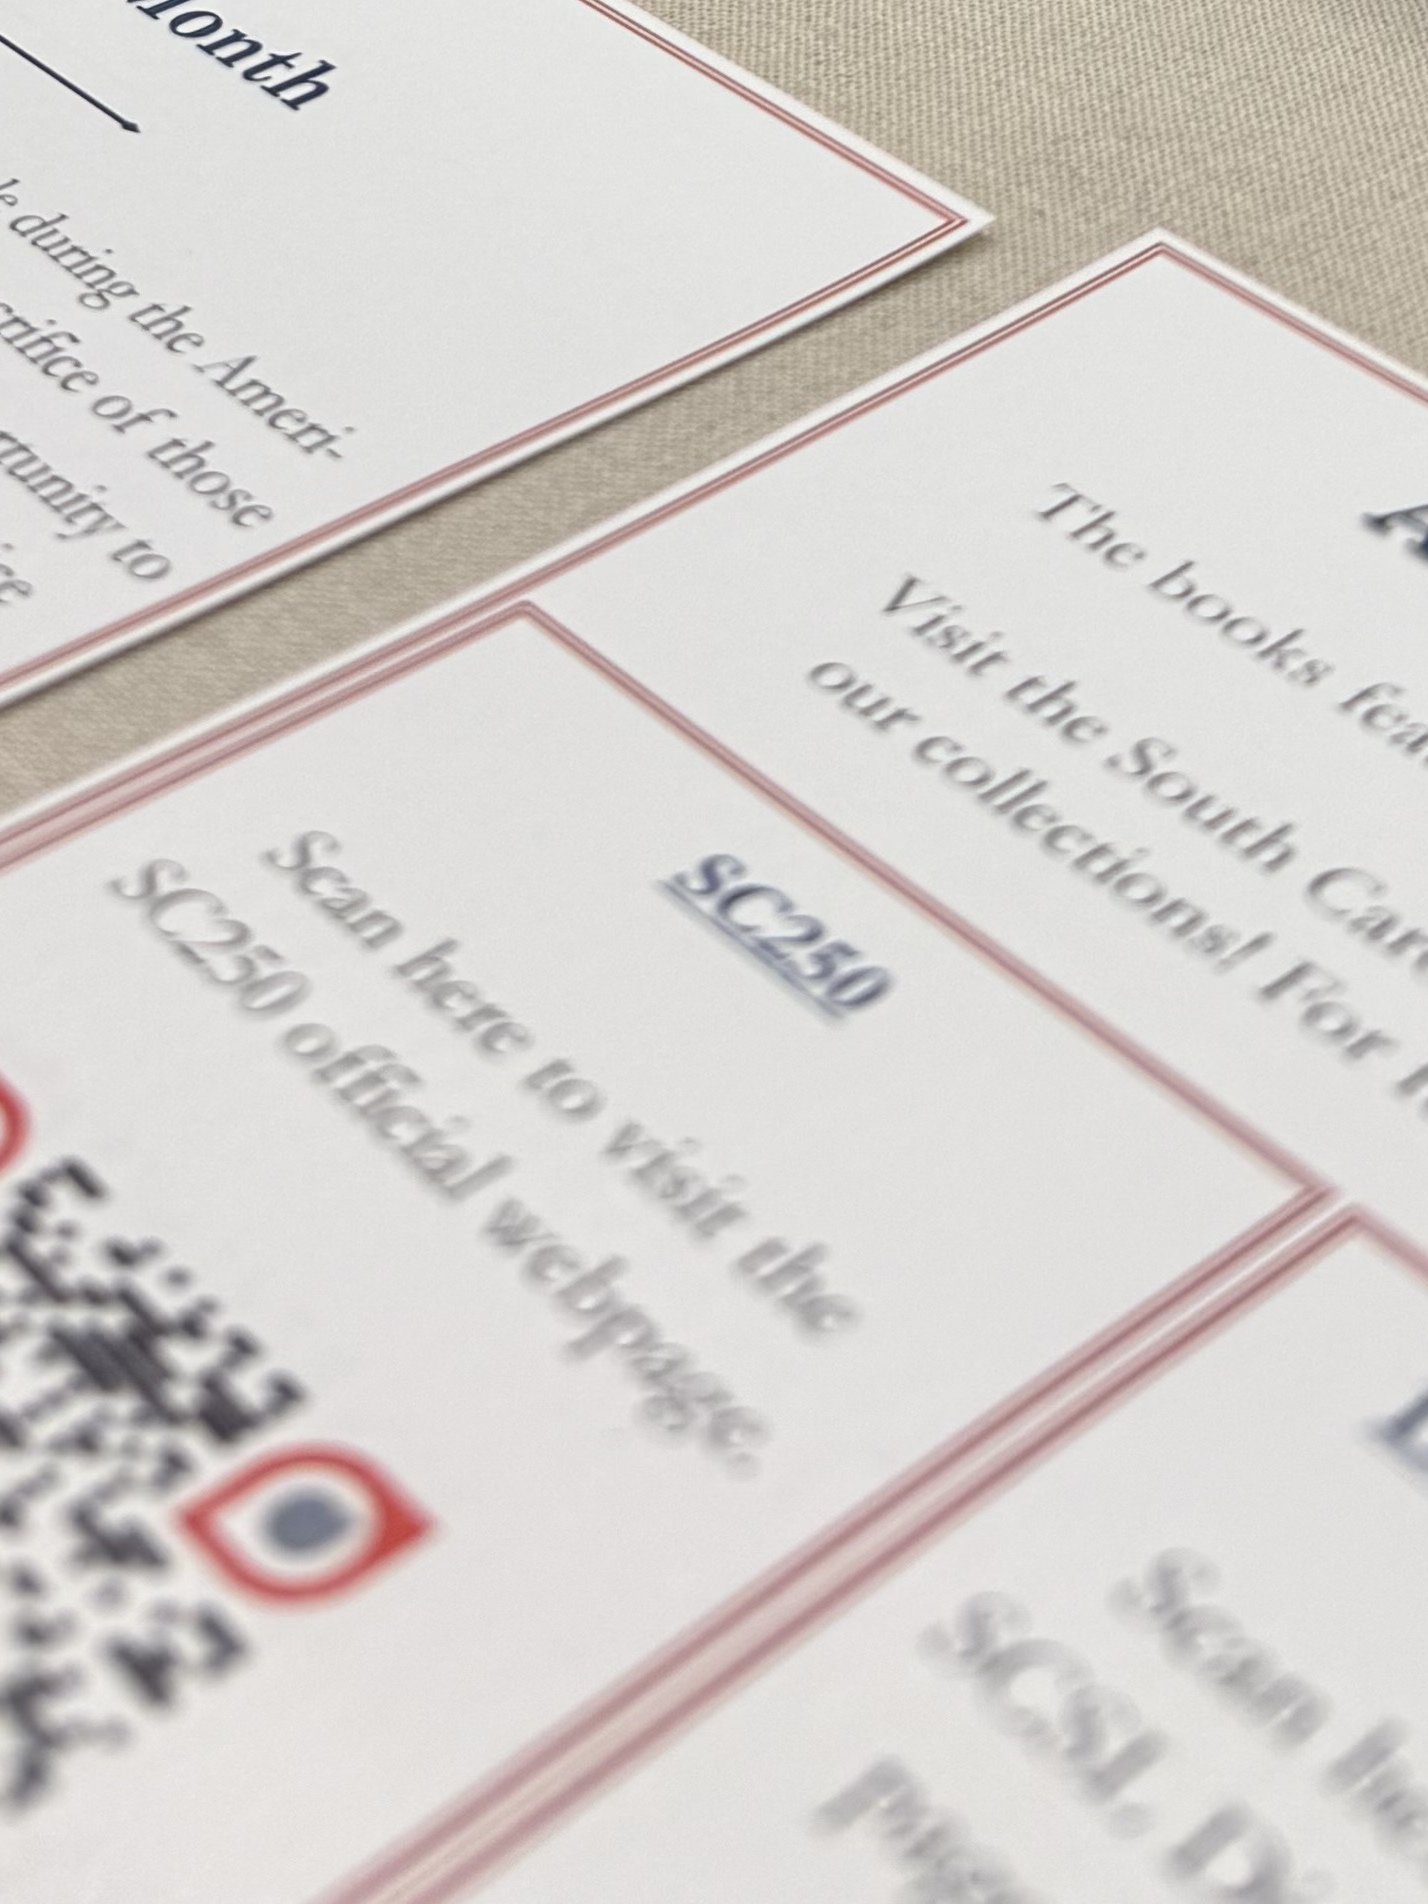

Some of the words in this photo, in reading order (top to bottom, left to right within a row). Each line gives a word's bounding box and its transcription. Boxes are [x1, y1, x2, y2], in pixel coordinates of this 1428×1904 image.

[6, 211, 141, 313] during
[126, 301, 207, 355] the
[191, 353, 356, 461] Ameri-
[89, 393, 180, 436] of
[144, 436, 275, 530] those
[107, 537, 173, 584] to
[1034, 480, 1149, 571] The
[1145, 557, 1335, 690] books
[879, 572, 1011, 680] Visit
[1002, 673, 1110, 747] the
[1101, 735, 1298, 876] South
[673, 853, 891, 1013] SC250
[806, 659, 923, 735] our
[911, 734, 1275, 971] collections!
[1256, 959, 1395, 1063] For
[104, 857, 311, 1022] SC250
[278, 1020, 514, 1205] official
[479, 1196, 766, 1467] webpage.
[258, 828, 407, 954] Scan
[388, 934, 533, 1060] here
[519, 1056, 605, 1126] to
[598, 1119, 751, 1245] visit
[730, 1235, 859, 1340] the
